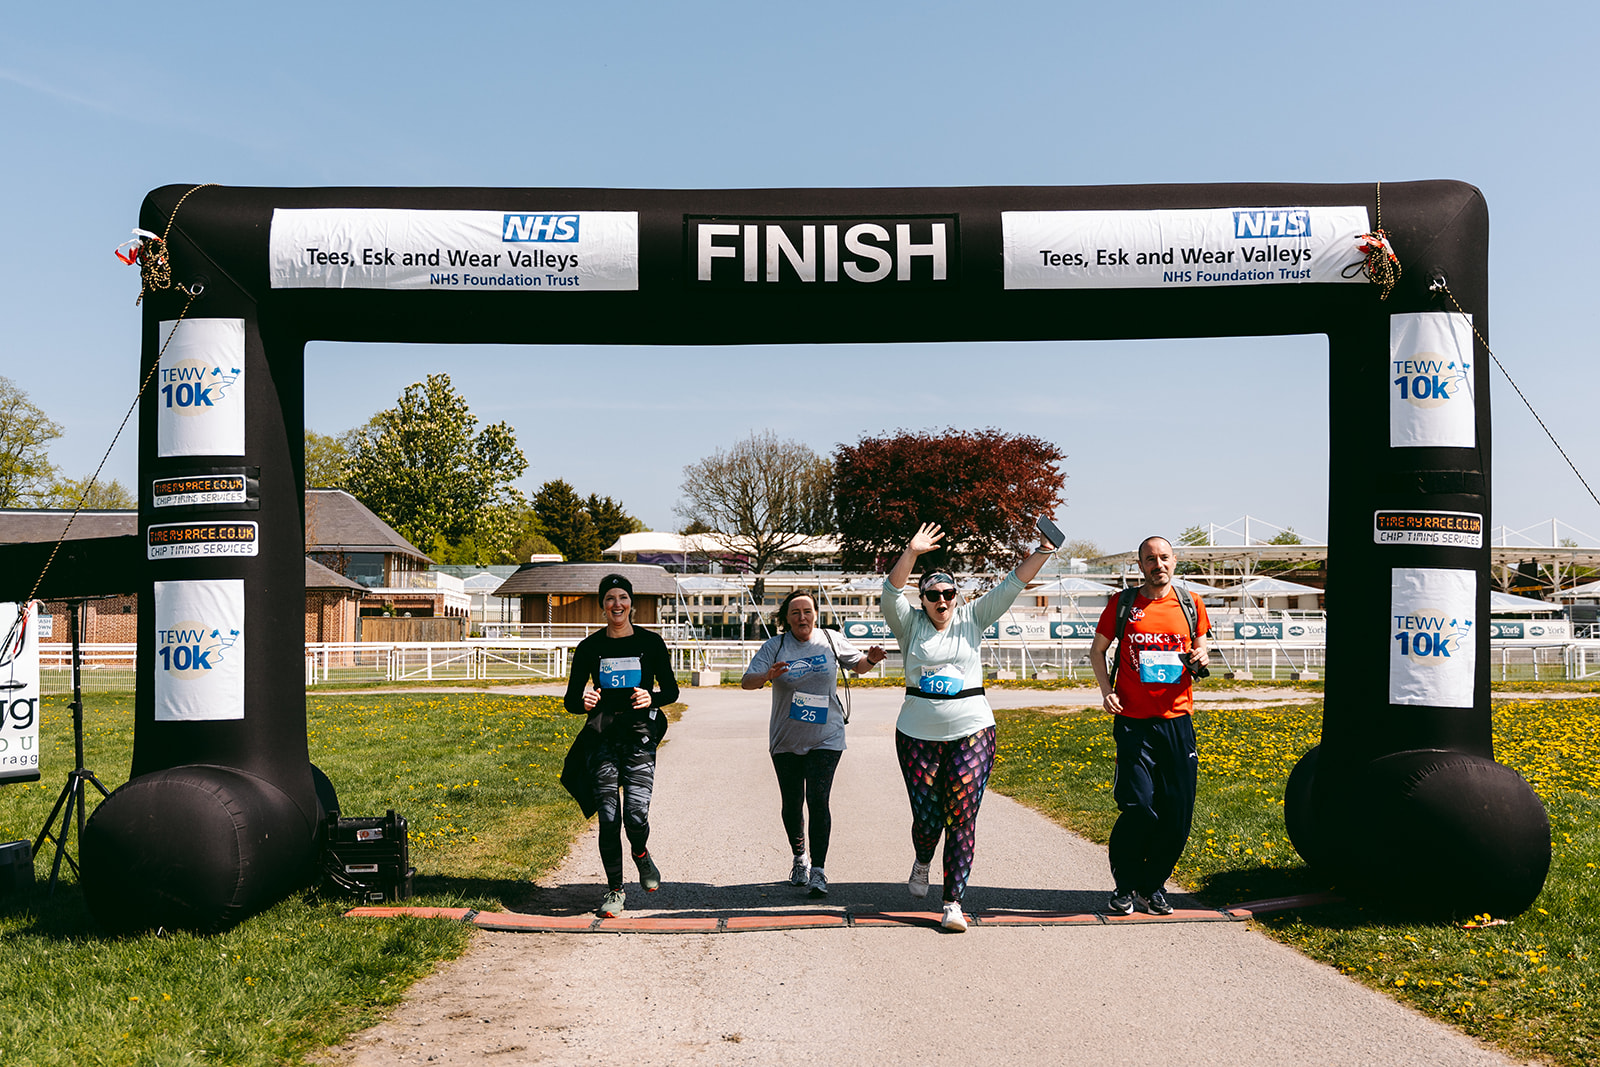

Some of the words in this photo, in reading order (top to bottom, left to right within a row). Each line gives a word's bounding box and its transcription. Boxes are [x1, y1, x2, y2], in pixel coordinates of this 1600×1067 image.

[504, 216, 577, 241] NHS
[1235, 212, 1309, 236] NHS
[306, 249, 356, 267] Tees,
[363, 248, 396, 266] Esk
[402, 248, 440, 267] and
[447, 250, 502, 267] Wear
[507, 250, 579, 272] Valleys
[698, 223, 947, 283] FINISH
[1039, 250, 1090, 269] Tees,
[1097, 248, 1130, 266] Esk
[1137, 247, 1174, 265] and
[1181, 248, 1236, 265] Wear
[1241, 245, 1312, 267] Valleys
[430, 274, 459, 286] NHS
[464, 274, 542, 286] Foundation
[546, 274, 580, 286] Trust
[1163, 271, 1192, 283] NHS
[1197, 268, 1275, 282] Foundation
[1278, 267, 1312, 281] Trust
[161, 367, 207, 382] TEWV
[1393, 360, 1443, 374] TEWV
[1394, 375, 1451, 399] 10k
[161, 382, 215, 408] 10k
[156, 496, 172, 506] CHIP
[174, 494, 199, 504] TIMING
[200, 493, 243, 502] SERVICES
[1380, 532, 1404, 542] CHIP
[1407, 532, 1439, 543] TIMING
[1442, 533, 1480, 546] SERVICES
[151, 547, 168, 558] CHIP
[170, 545, 200, 556] TIMING
[203, 543, 254, 554] SERVICES
[869, 624, 892, 634] York
[1026, 625, 1046, 634] York
[1258, 625, 1279, 635] York
[1393, 615, 1445, 631] TEWV
[1500, 625, 1520, 635] York
[1547, 626, 1566, 634] York
[158, 629, 205, 644] TEWV
[1394, 631, 1451, 657] 10k
[158, 645, 213, 671] 10k
[611, 675, 626, 687] 51
[1157, 669, 1166, 682] 5
[929, 680, 952, 693] 197
[801, 709, 817, 722] 25
